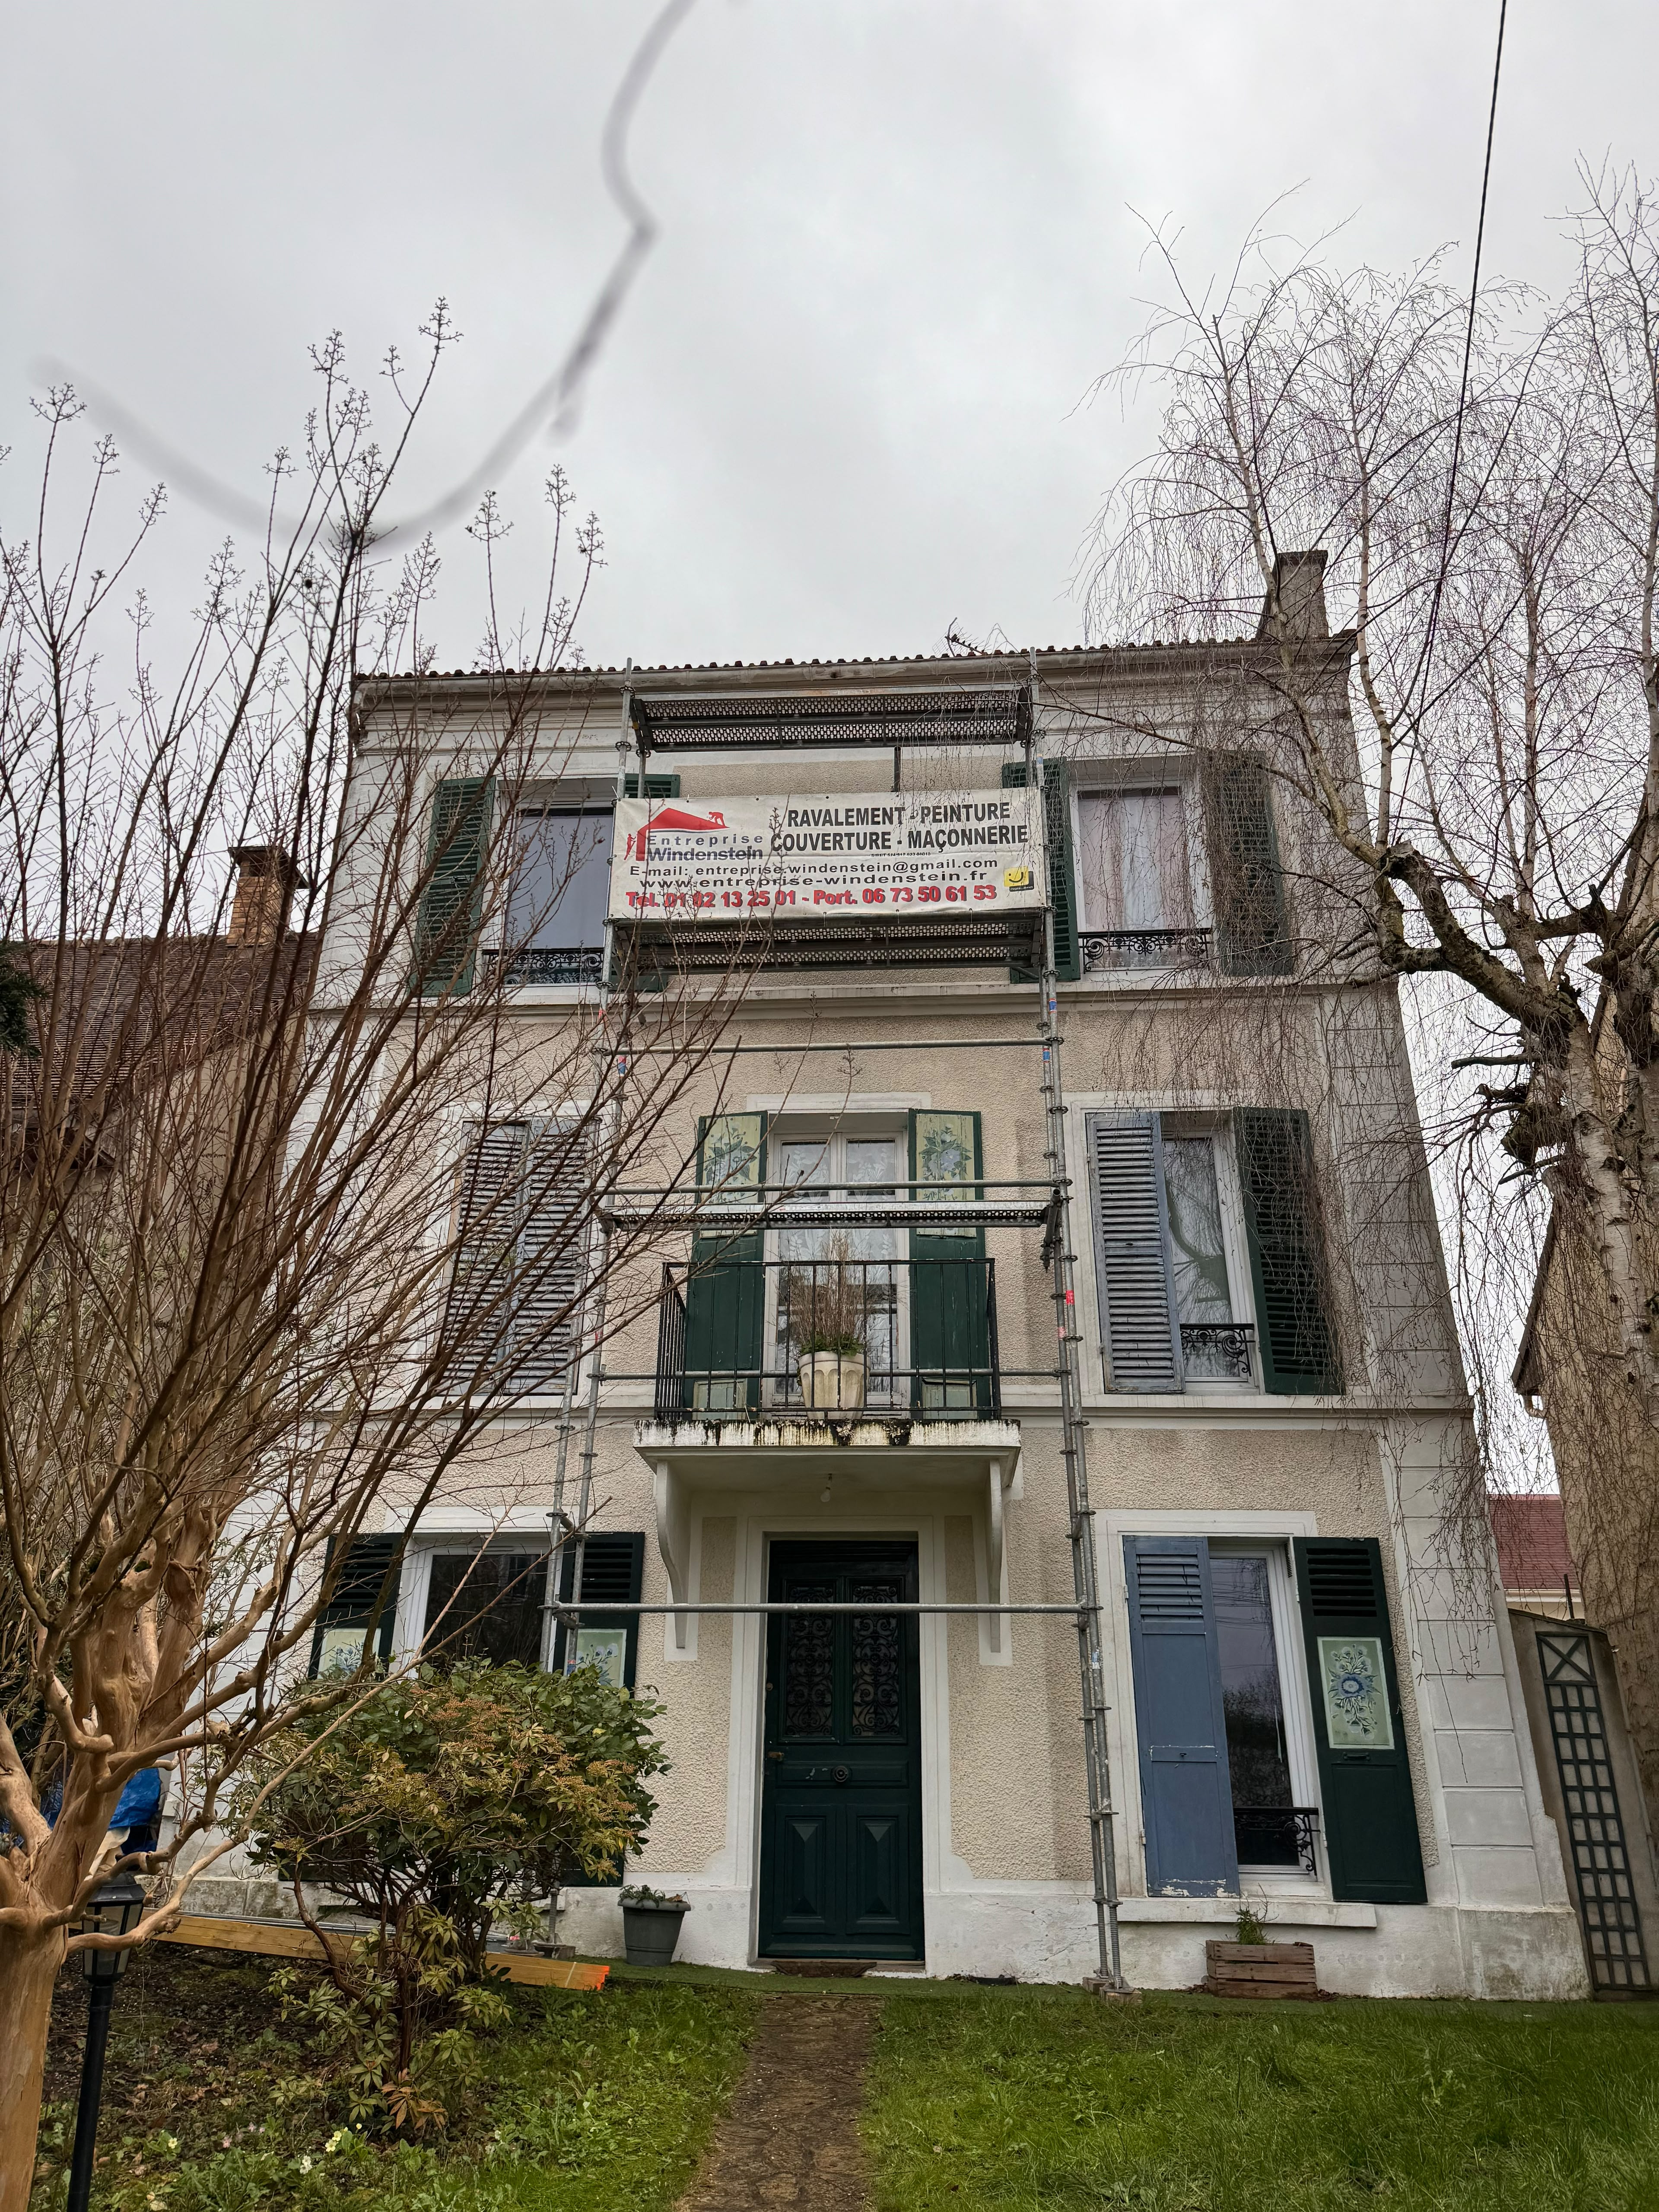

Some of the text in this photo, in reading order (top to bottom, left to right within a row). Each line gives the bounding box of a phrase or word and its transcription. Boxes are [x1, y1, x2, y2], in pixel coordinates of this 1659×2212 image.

[788, 807, 905, 827] RAVALEMENT
[921, 802, 1010, 823] PEINTURE
[648, 834, 763, 847] Entreprise
[771, 832, 891, 852] COUVERTURE
[908, 825, 1028, 853] MAÇONNERIE
[648, 847, 763, 861] Windenstein
[630, 859, 998, 876] E-mail: entreprise.windenstein@gmail.com
[721, 891, 743, 907] 13
[747, 891, 770, 907] 25
[775, 890, 796, 906] 01
[814, 890, 858, 905] Port.
[862, 888, 885, 904] 06
[890, 887, 913, 902] 73
[918, 886, 941, 902] 50
[945, 886, 967, 902] 61
[973, 884, 998, 900] 53
